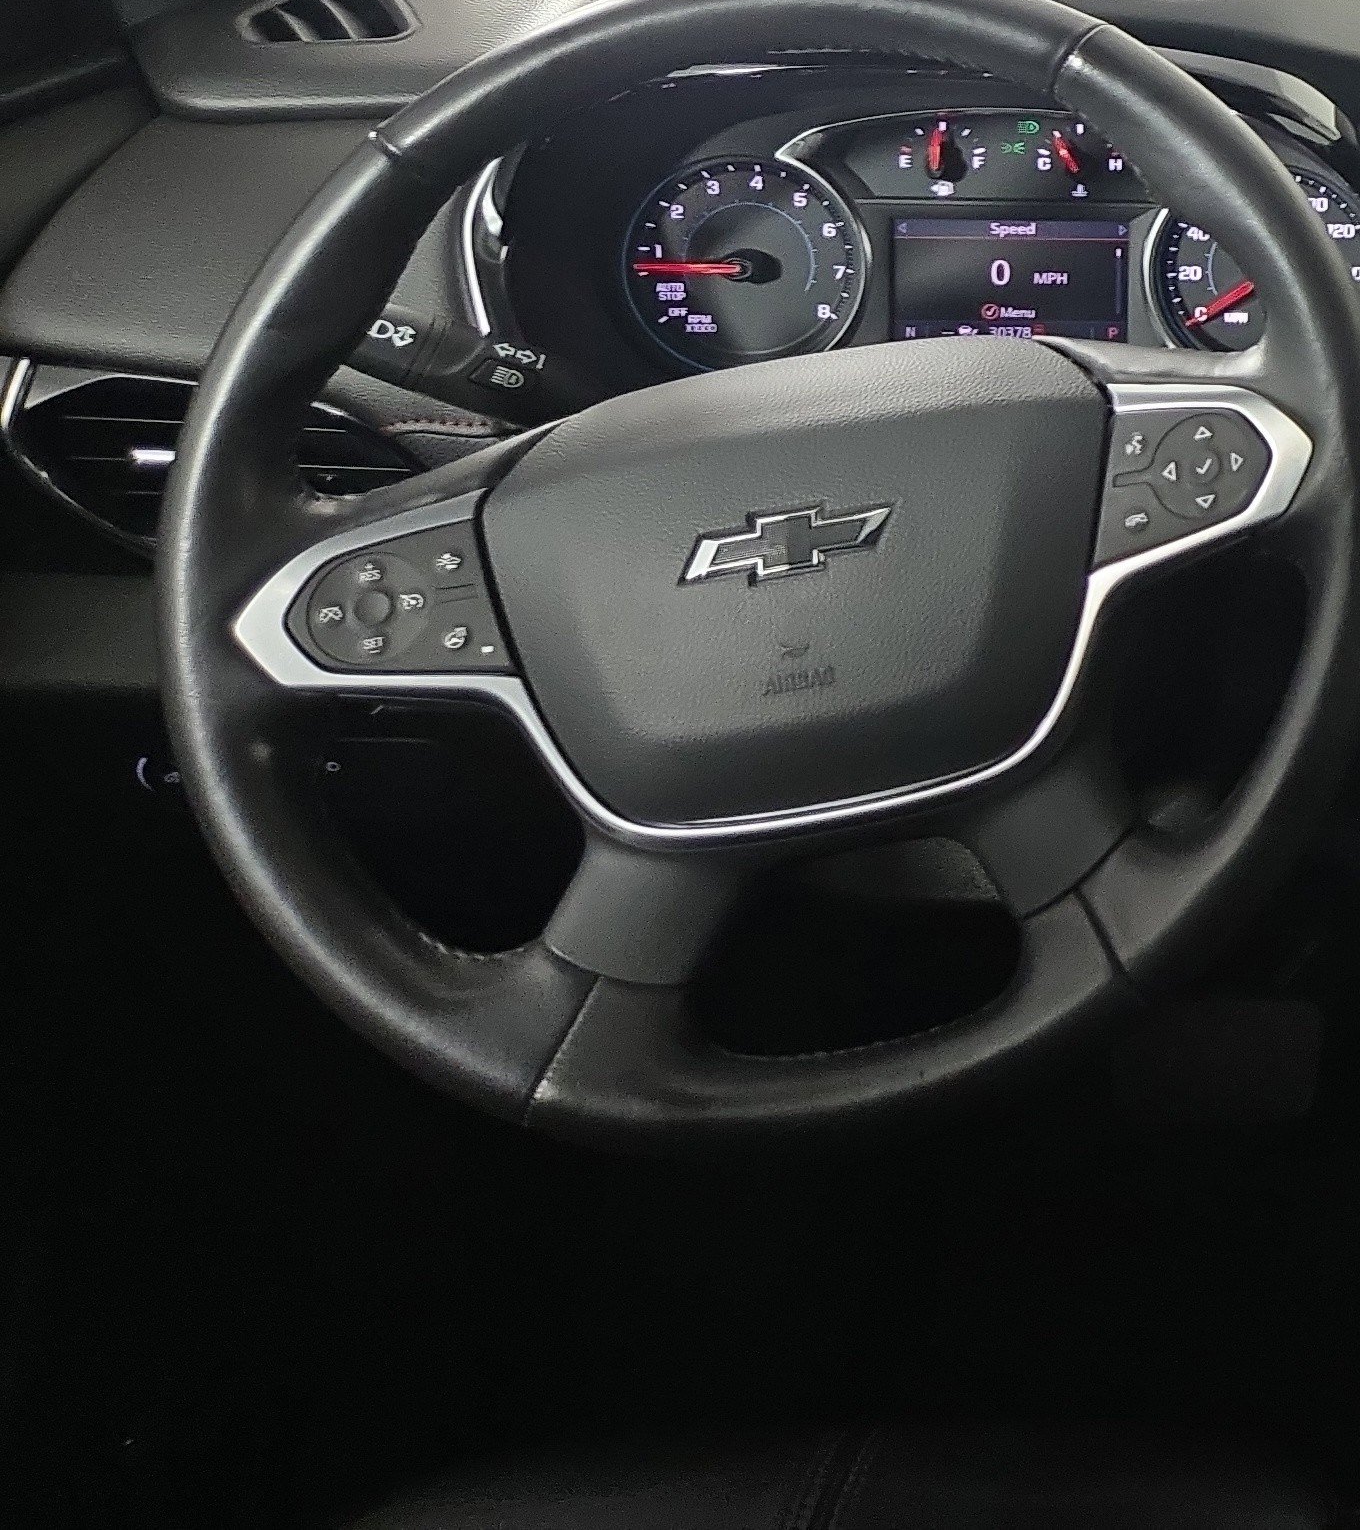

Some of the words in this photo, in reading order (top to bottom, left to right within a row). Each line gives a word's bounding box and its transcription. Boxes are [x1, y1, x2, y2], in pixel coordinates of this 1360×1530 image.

[899, 154, 913, 169] E
[972, 156, 986, 170] F
[1037, 157, 1052, 171] C
[1108, 158, 1123, 171] H
[706, 180, 721, 195] 3
[749, 176, 764, 190] 4
[793, 192, 808, 207] 5
[670, 204, 685, 219] 2
[822, 223, 836, 237] 6
[989, 222, 1037, 237] Speed
[654, 244, 663, 258] 1
[832, 266, 846, 280] 7
[990, 259, 1011, 286] 0
[1033, 272, 1068, 285] MPH
[1178, 265, 1203, 281] 20
[817, 304, 831, 318] 8
[1000, 307, 1036, 319] Menu
[905, 327, 916, 338] N
[1107, 327, 1118, 339] P
